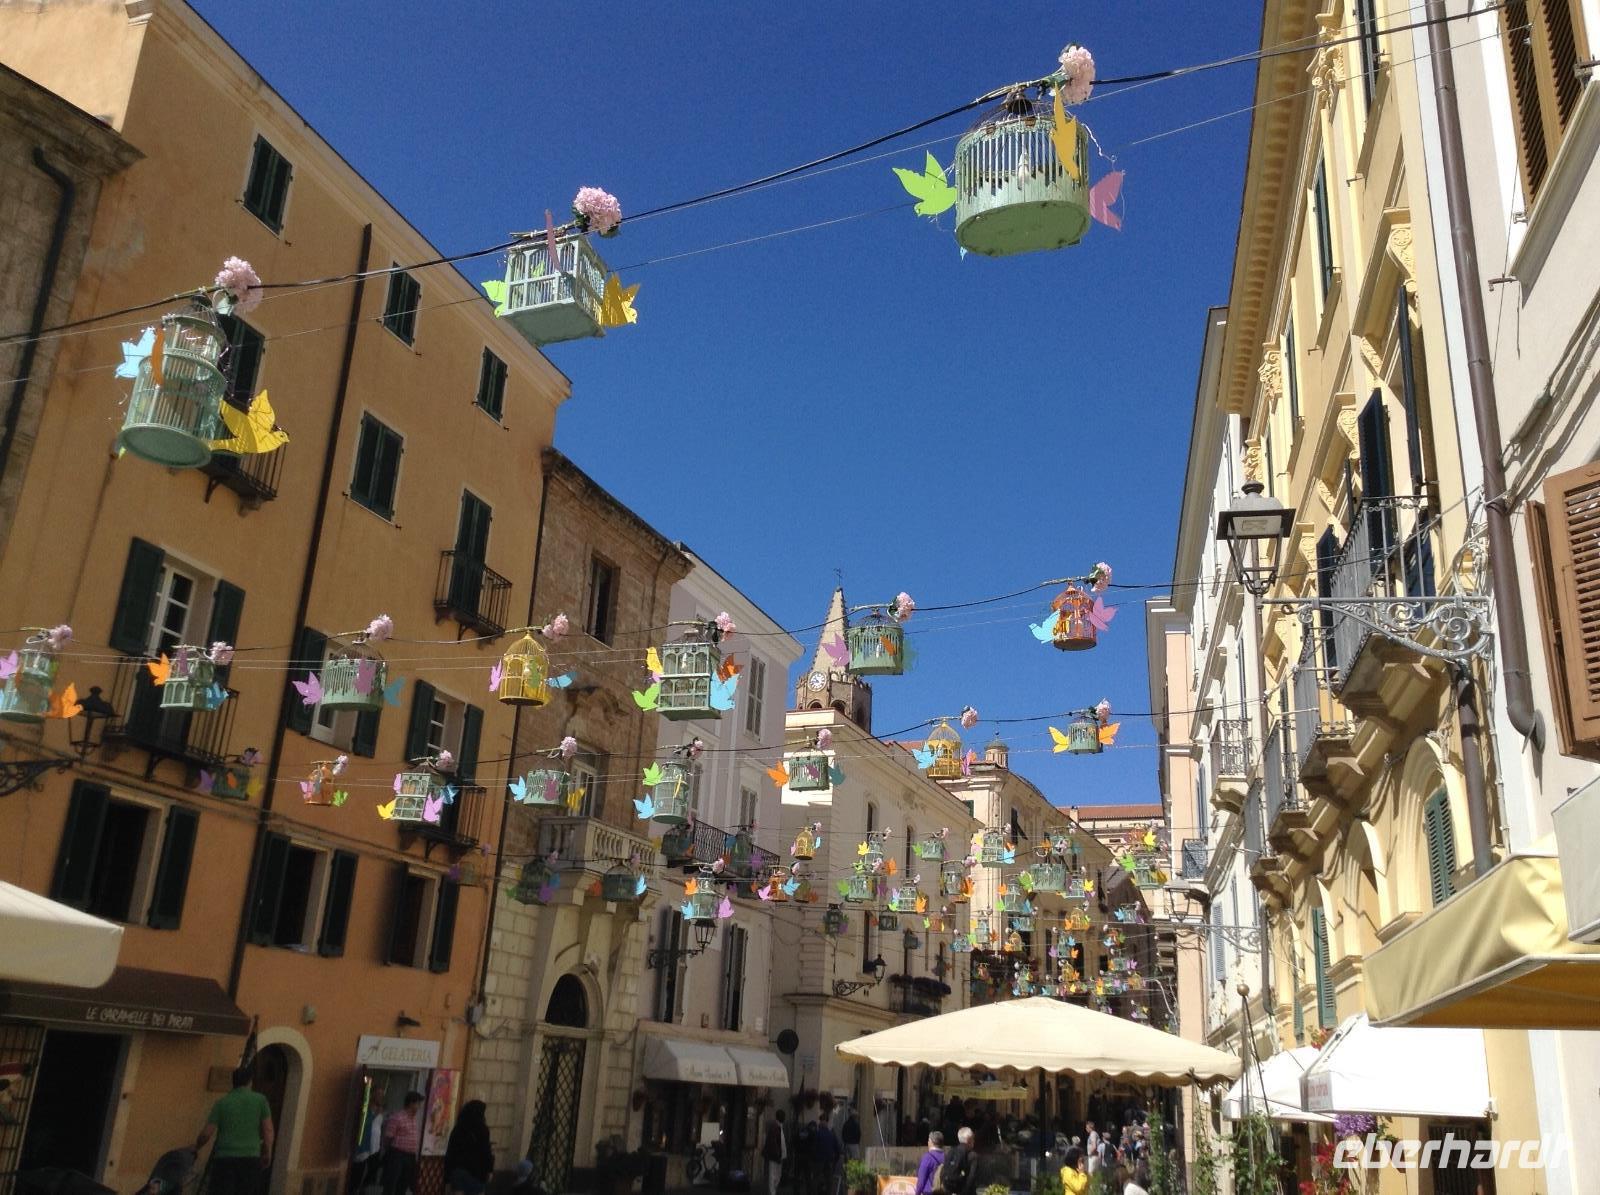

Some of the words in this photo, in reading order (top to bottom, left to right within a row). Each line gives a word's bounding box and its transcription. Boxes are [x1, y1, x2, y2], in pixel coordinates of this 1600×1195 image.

[86, 1007, 97, 1020] LE
[100, 1008, 149, 1025] CARAMELLE
[152, 1012, 165, 1027] DEI
[382, 1046, 431, 1063] GELATERIA
